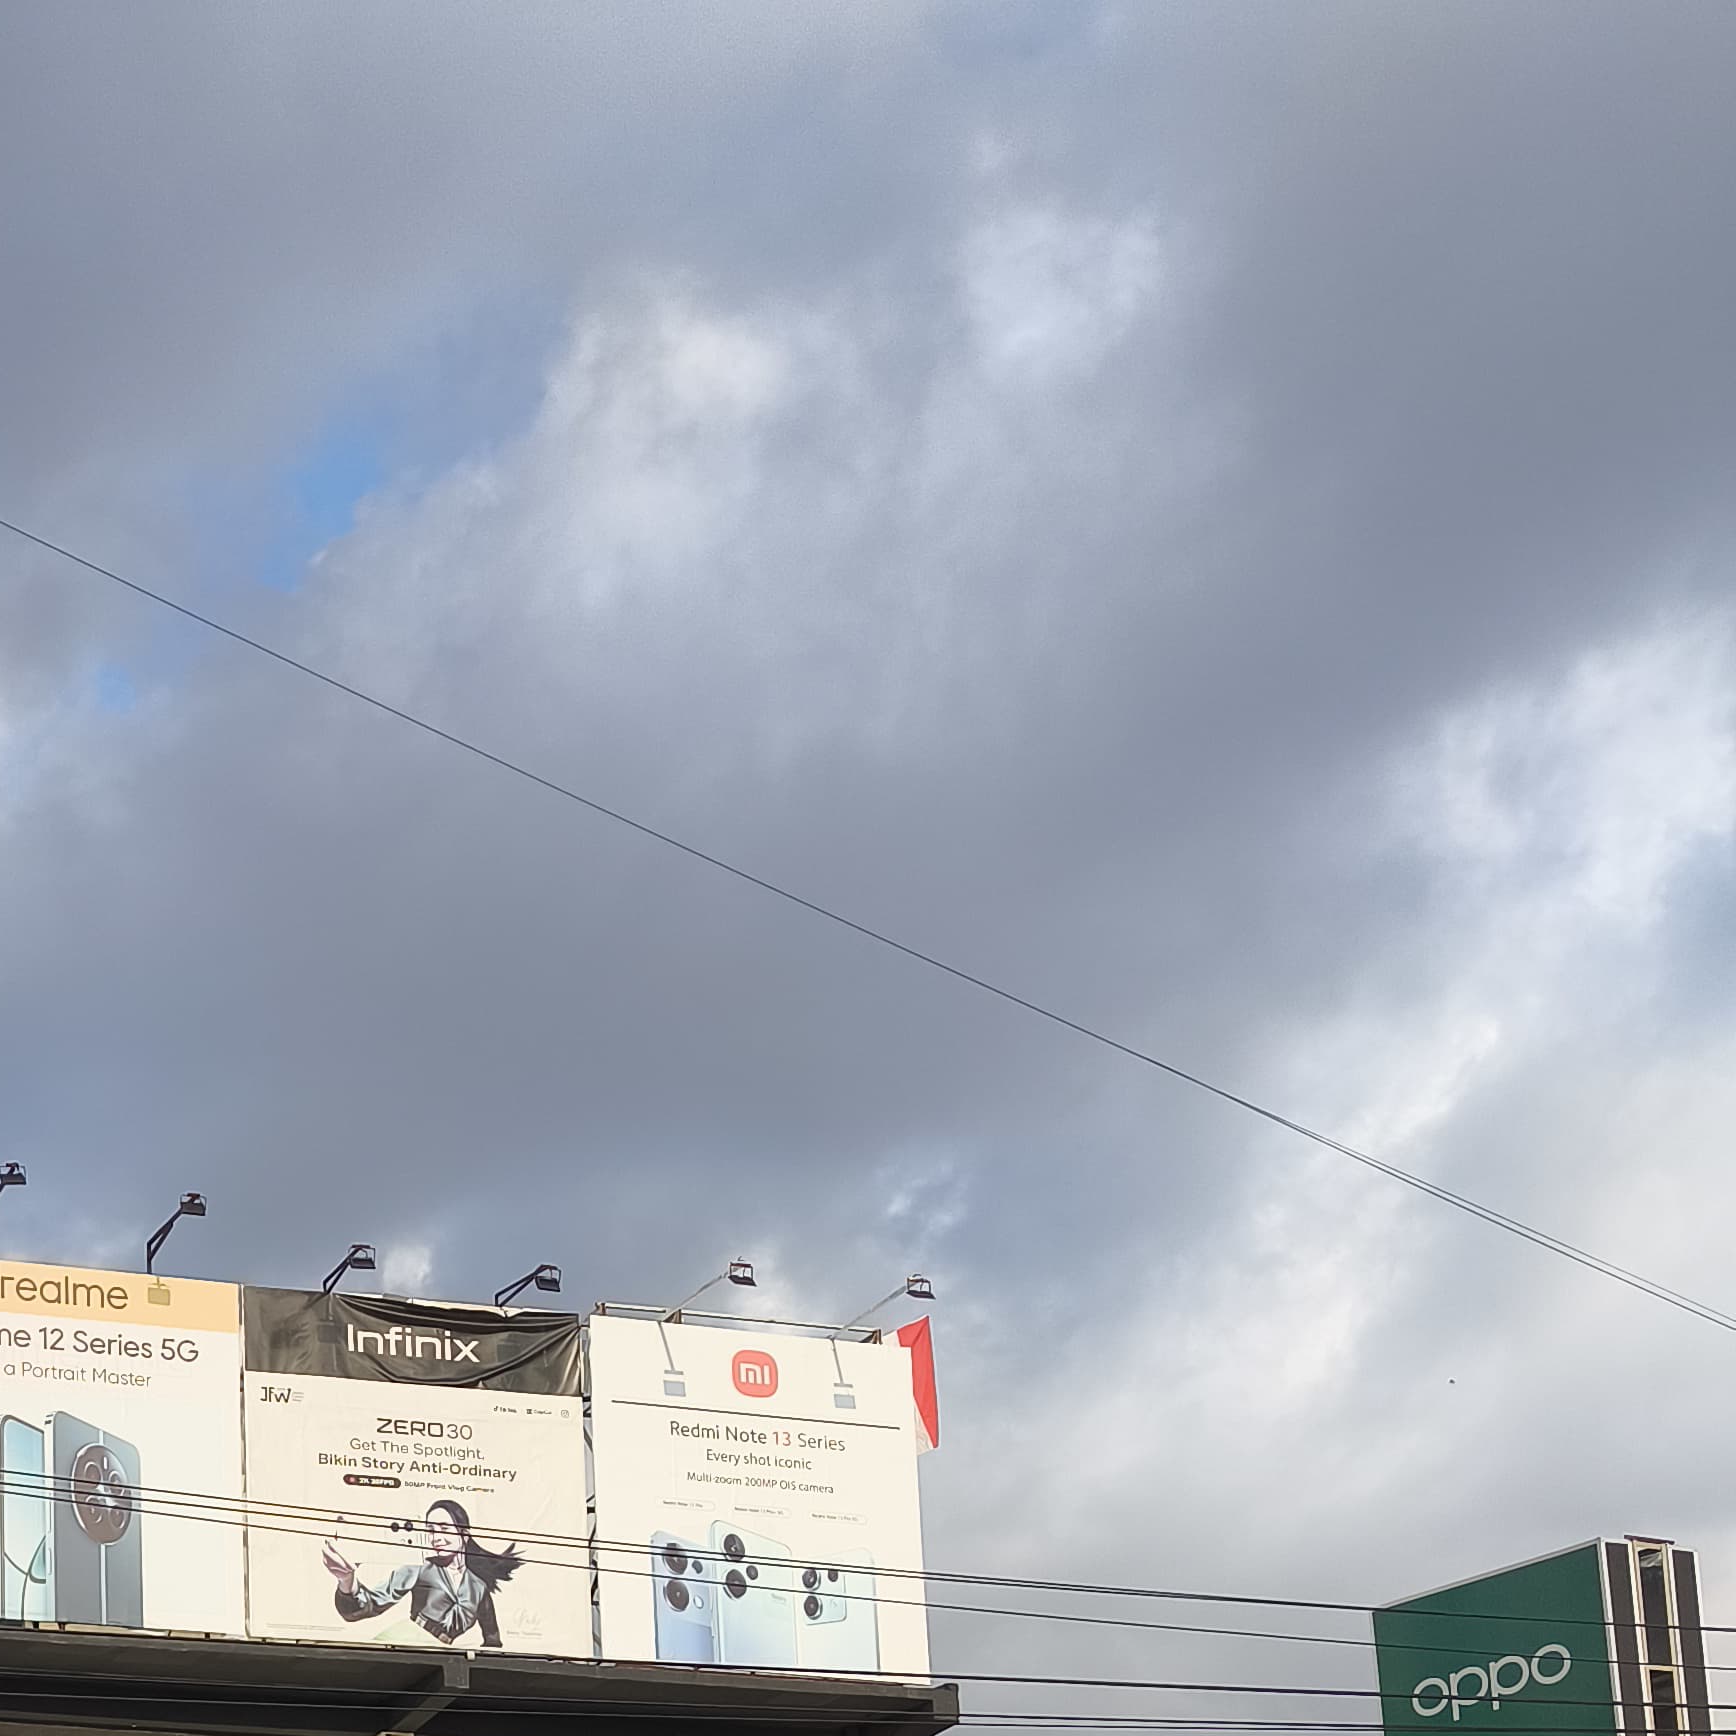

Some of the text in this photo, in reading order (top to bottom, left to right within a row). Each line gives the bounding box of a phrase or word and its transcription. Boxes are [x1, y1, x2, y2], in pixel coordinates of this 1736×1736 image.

[0, 1275, 128, 1310] realme
[39, 1327, 64, 1351] 12
[72, 1330, 152, 1359] Series
[160, 1338, 199, 1363] 5G
[347, 1323, 480, 1363] Infinix
[3, 1364, 15, 1376] a
[22, 1362, 86, 1382] Portrait
[92, 1368, 151, 1388] Master
[350, 1438, 376, 1453] Get
[380, 1440, 409, 1454] The
[669, 1420, 846, 1452] Redmi Note 13 Series
[318, 1453, 517, 1481] Bikin Story Anti-Ordinary
[706, 1448, 741, 1466] Every
[745, 1476, 778, 1489] 200MP
[779, 1479, 796, 1491] OIS
[798, 1482, 834, 1494] camera
[1412, 1644, 1571, 1721] oppo
